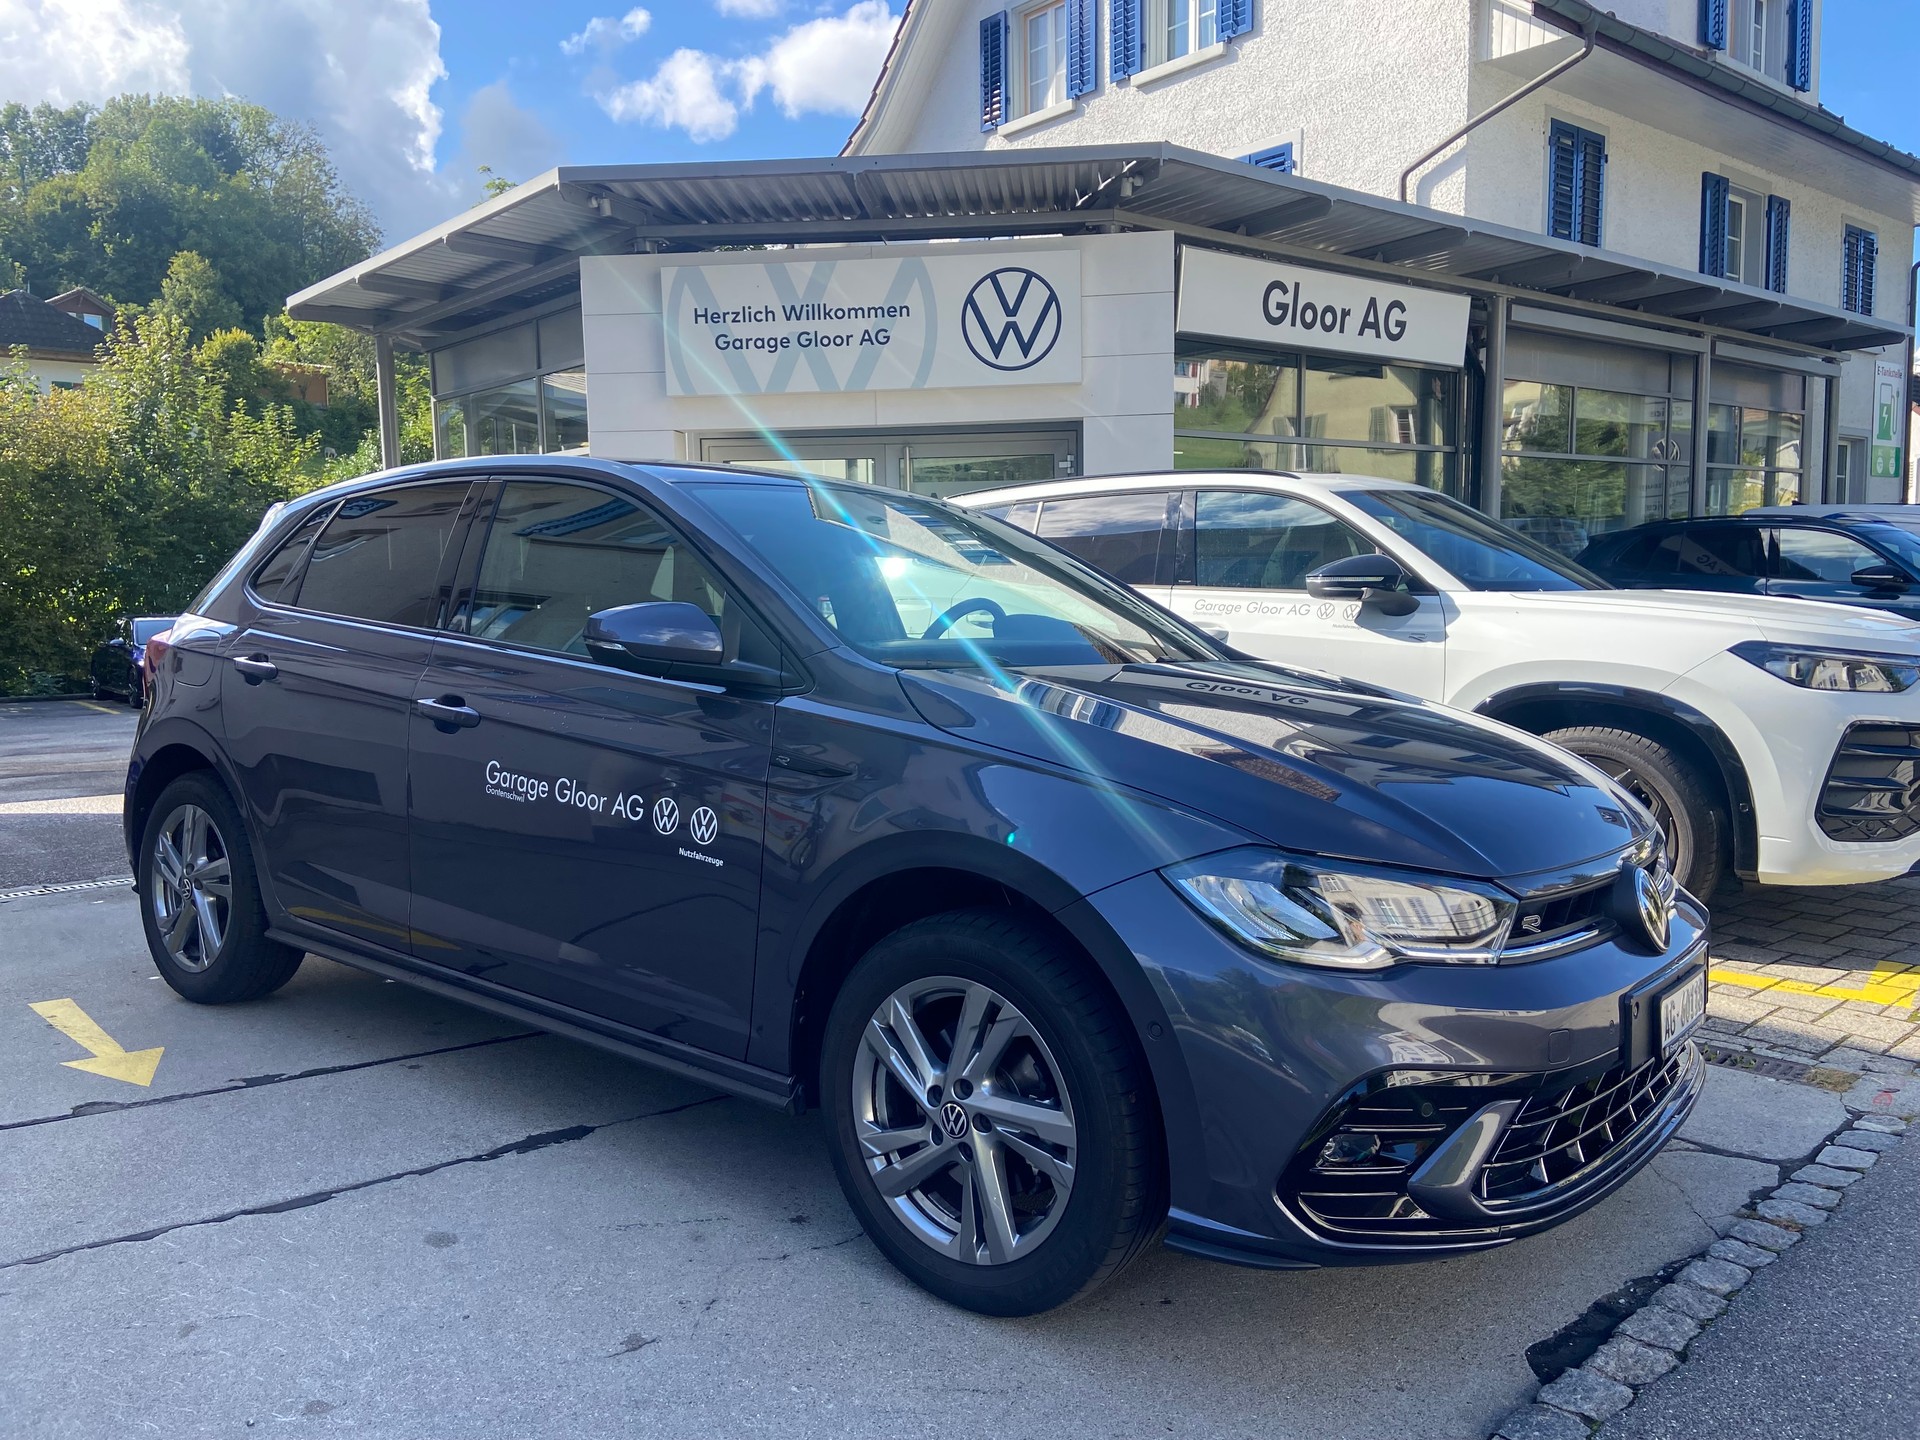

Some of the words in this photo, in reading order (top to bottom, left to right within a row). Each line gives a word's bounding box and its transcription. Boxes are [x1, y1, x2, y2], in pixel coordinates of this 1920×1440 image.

[693, 305, 776, 324] Herzlich
[782, 303, 911, 321] Willkommen
[1262, 279, 1351, 334] Gloor
[1357, 296, 1407, 342] AG
[714, 334, 791, 353] Garage
[796, 330, 853, 349] Gloor
[859, 328, 891, 346] AG
[1194, 599, 1242, 615] Garage
[1246, 601, 1285, 615] Gloor
[1286, 603, 1311, 616] AG
[485, 784, 525, 803] Gontenschwil
[486, 760, 548, 801] Garage
[555, 778, 607, 812] Gloor
[611, 791, 644, 821] AG
[679, 847, 724, 867] Nutzfahrzeuge
